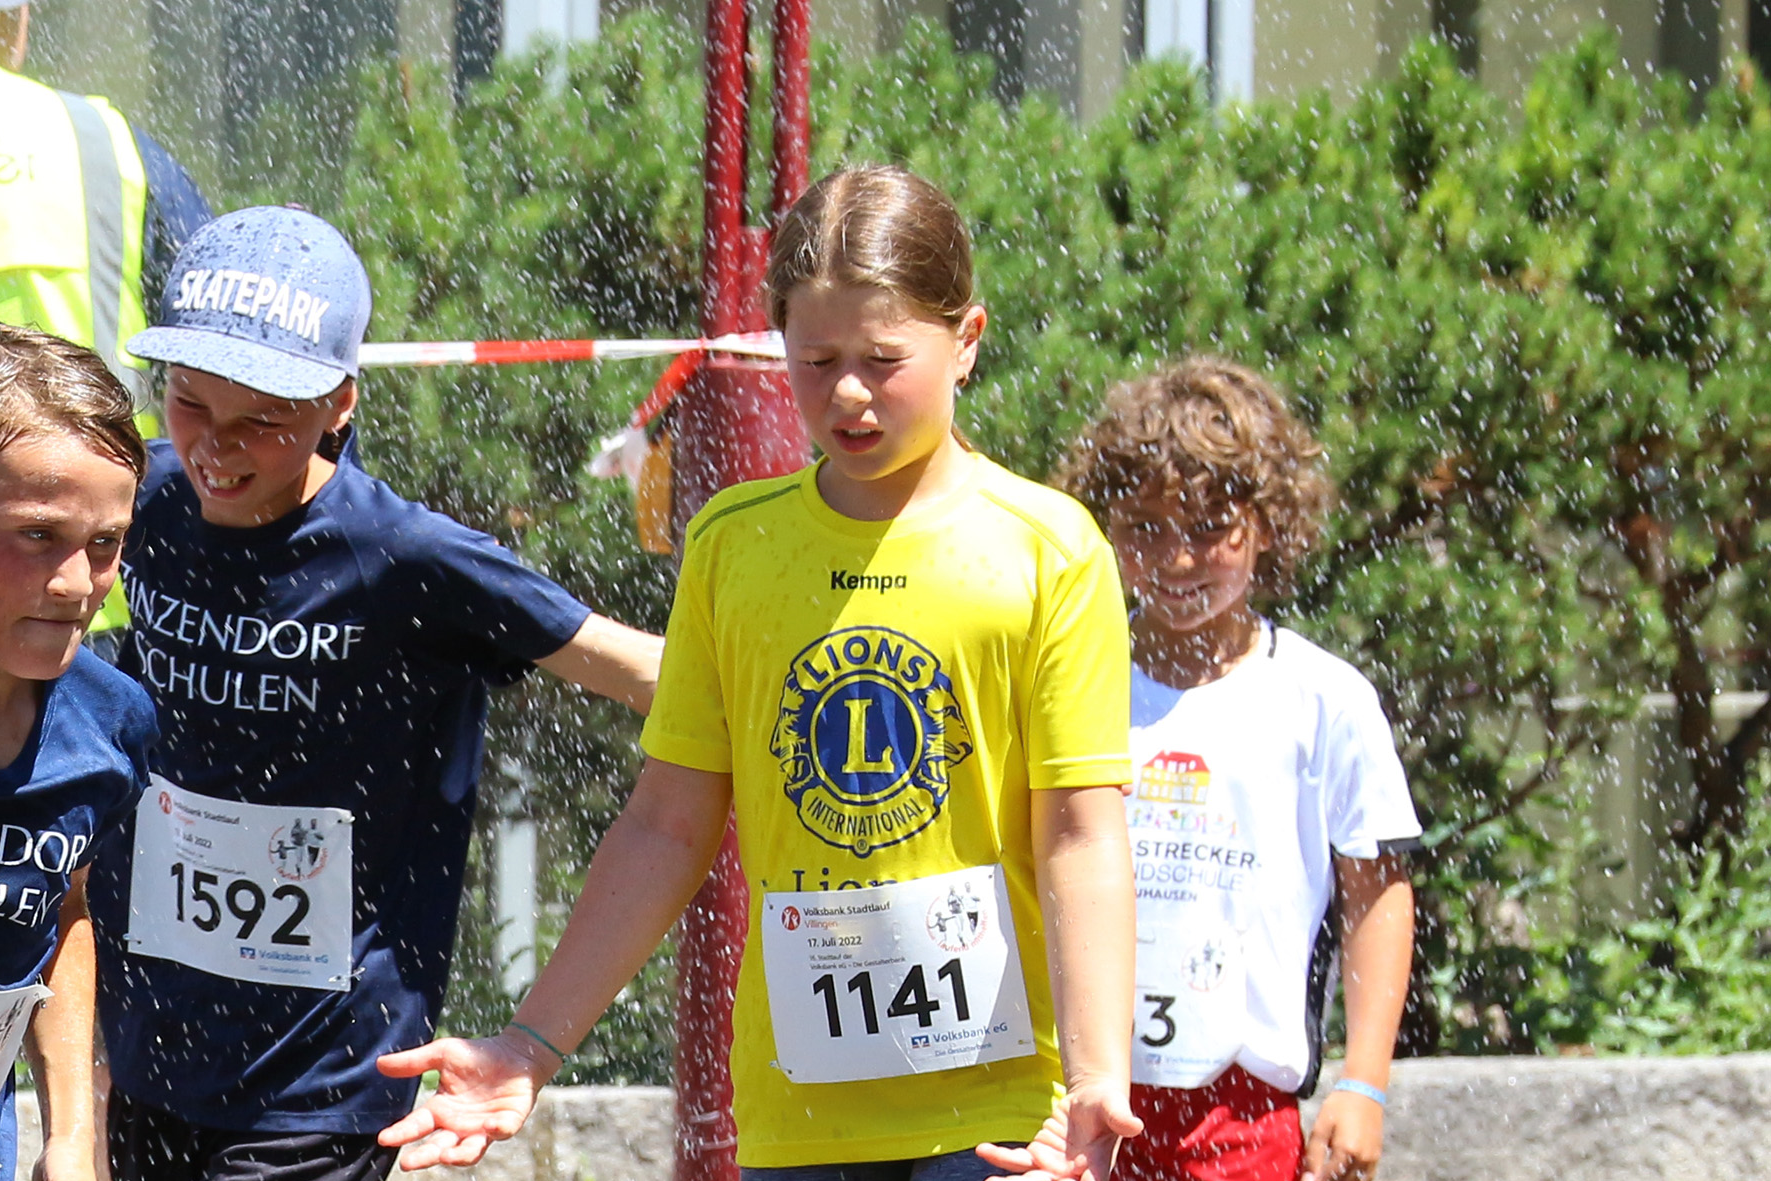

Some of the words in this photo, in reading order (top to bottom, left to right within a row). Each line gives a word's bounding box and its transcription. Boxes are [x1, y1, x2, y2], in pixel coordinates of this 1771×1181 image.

[172, 269, 330, 344] SKATEPARK
[830, 570, 907, 594] Kempa
[134, 630, 318, 713] SCHULEN
[801, 635, 927, 684] LIONS
[841, 698, 895, 774] L
[806, 796, 926, 837] INTERNATIONAL
[170, 862, 311, 946] 1592
[803, 906, 845, 917] Volksbank
[847, 901, 891, 915] Stadtlauf
[804, 919, 839, 930] Villingen
[807, 938, 819, 948] 17.
[821, 937, 836, 948] Juli
[839, 935, 863, 947] 2022
[812, 958, 971, 1038] 1141
[1132, 993, 1177, 1048] 3
[933, 1025, 991, 1043] Volksbank
[992, 1022, 1008, 1034] eG
